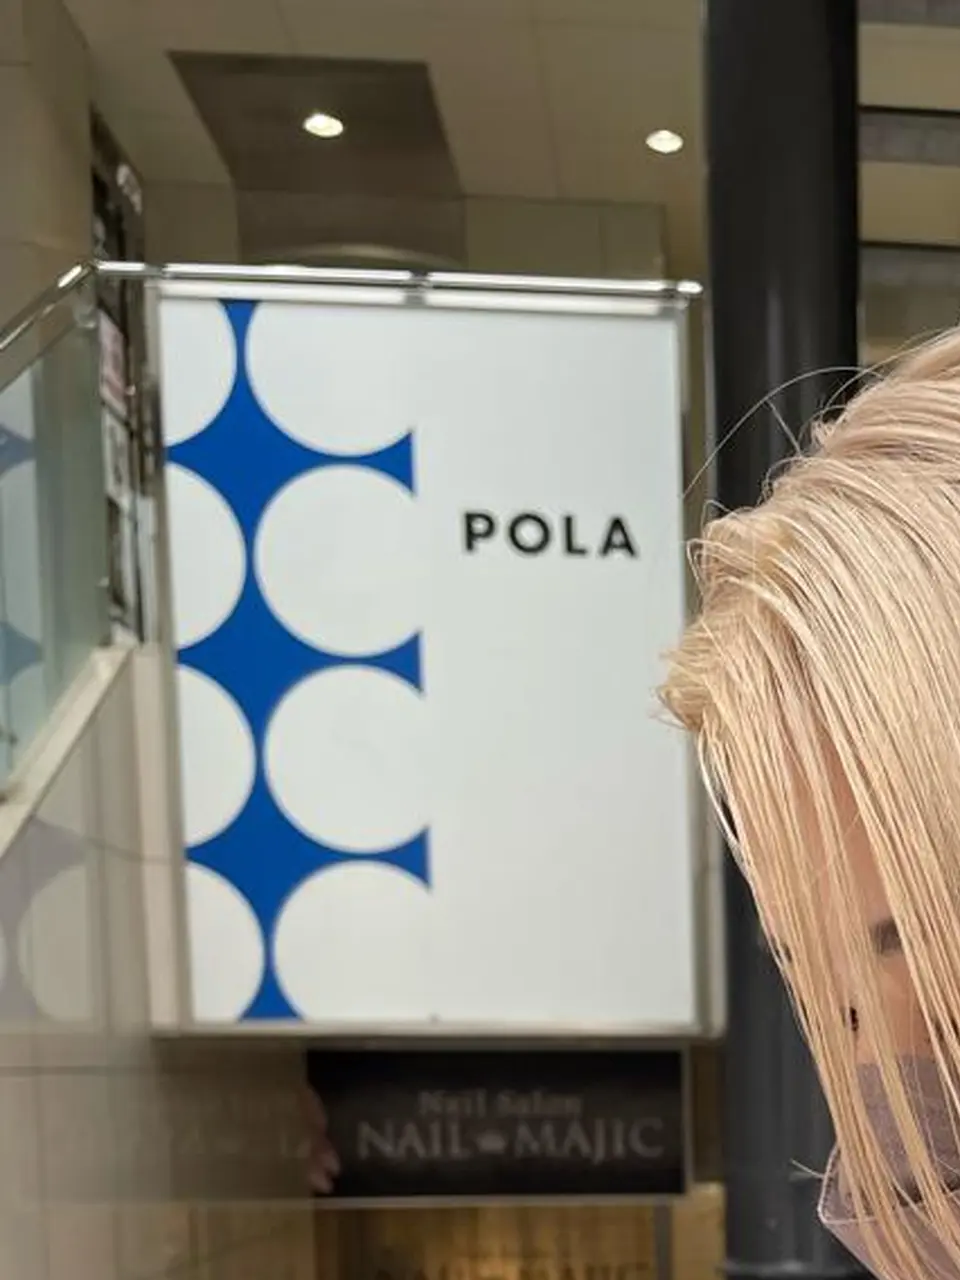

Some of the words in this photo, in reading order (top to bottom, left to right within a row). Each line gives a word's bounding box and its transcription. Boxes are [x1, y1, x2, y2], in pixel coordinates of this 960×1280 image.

[464, 512, 637, 557] POLA
[356, 1119, 473, 1160] NAIL
[513, 1117, 666, 1165] MAJIC
